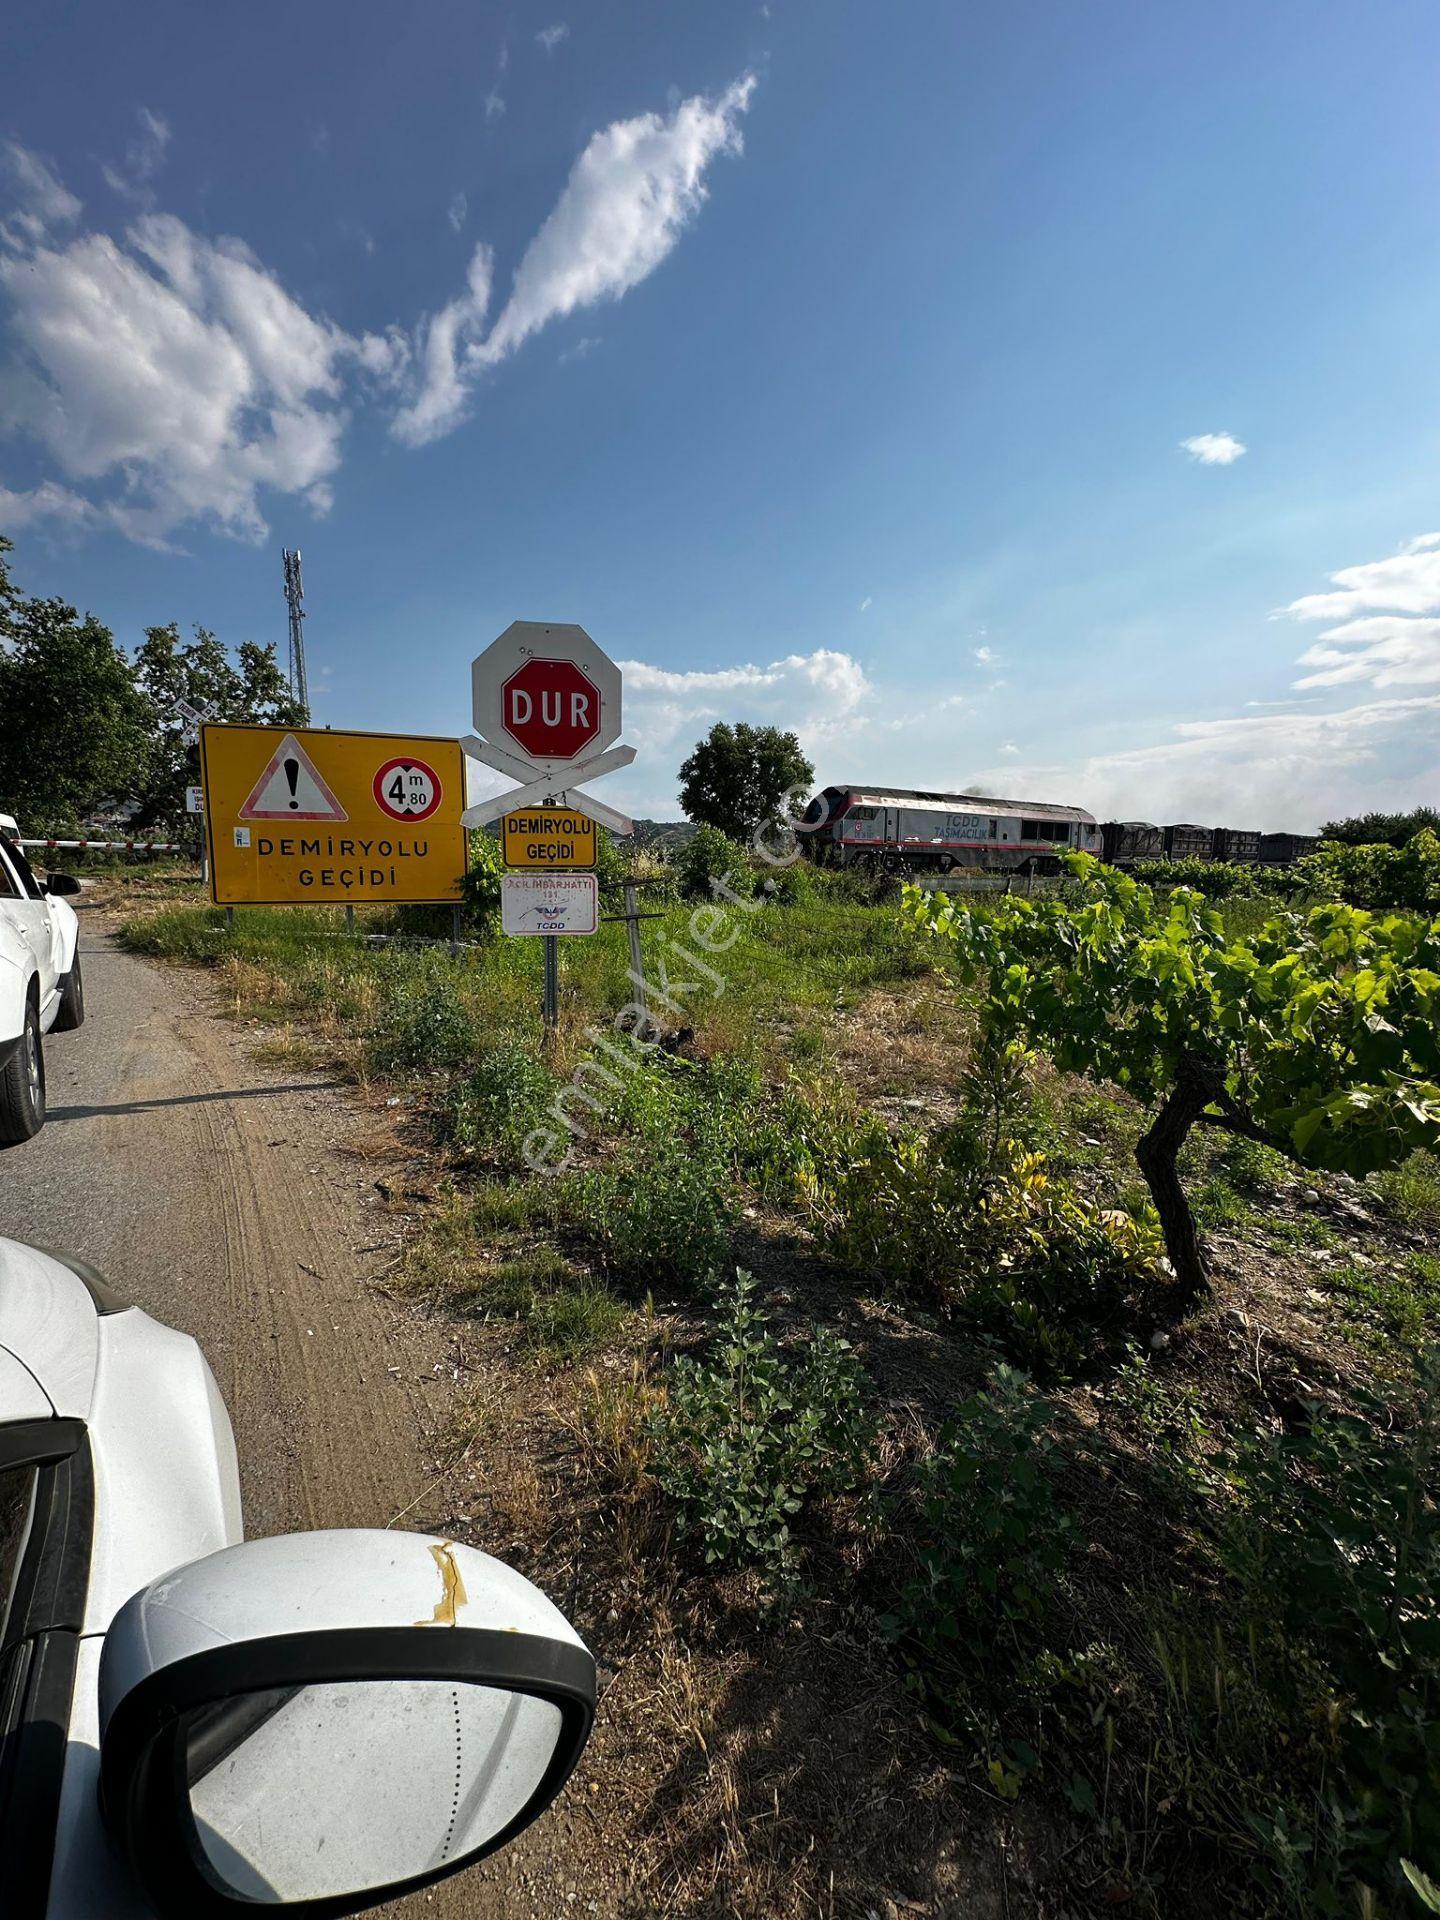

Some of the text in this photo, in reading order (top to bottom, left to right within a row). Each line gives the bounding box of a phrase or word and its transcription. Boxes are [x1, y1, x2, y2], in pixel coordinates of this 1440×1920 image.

[511, 689, 590, 728] DUR
[508, 815, 591, 834] DEMİRYOLU
[945, 815, 980, 827] TCDD
[258, 836, 428, 857] DEMİRYOLU
[527, 840, 574, 862] GEÇİDİ
[299, 866, 396, 889] GEÇİDİ
[536, 922, 566, 930] TCDD
